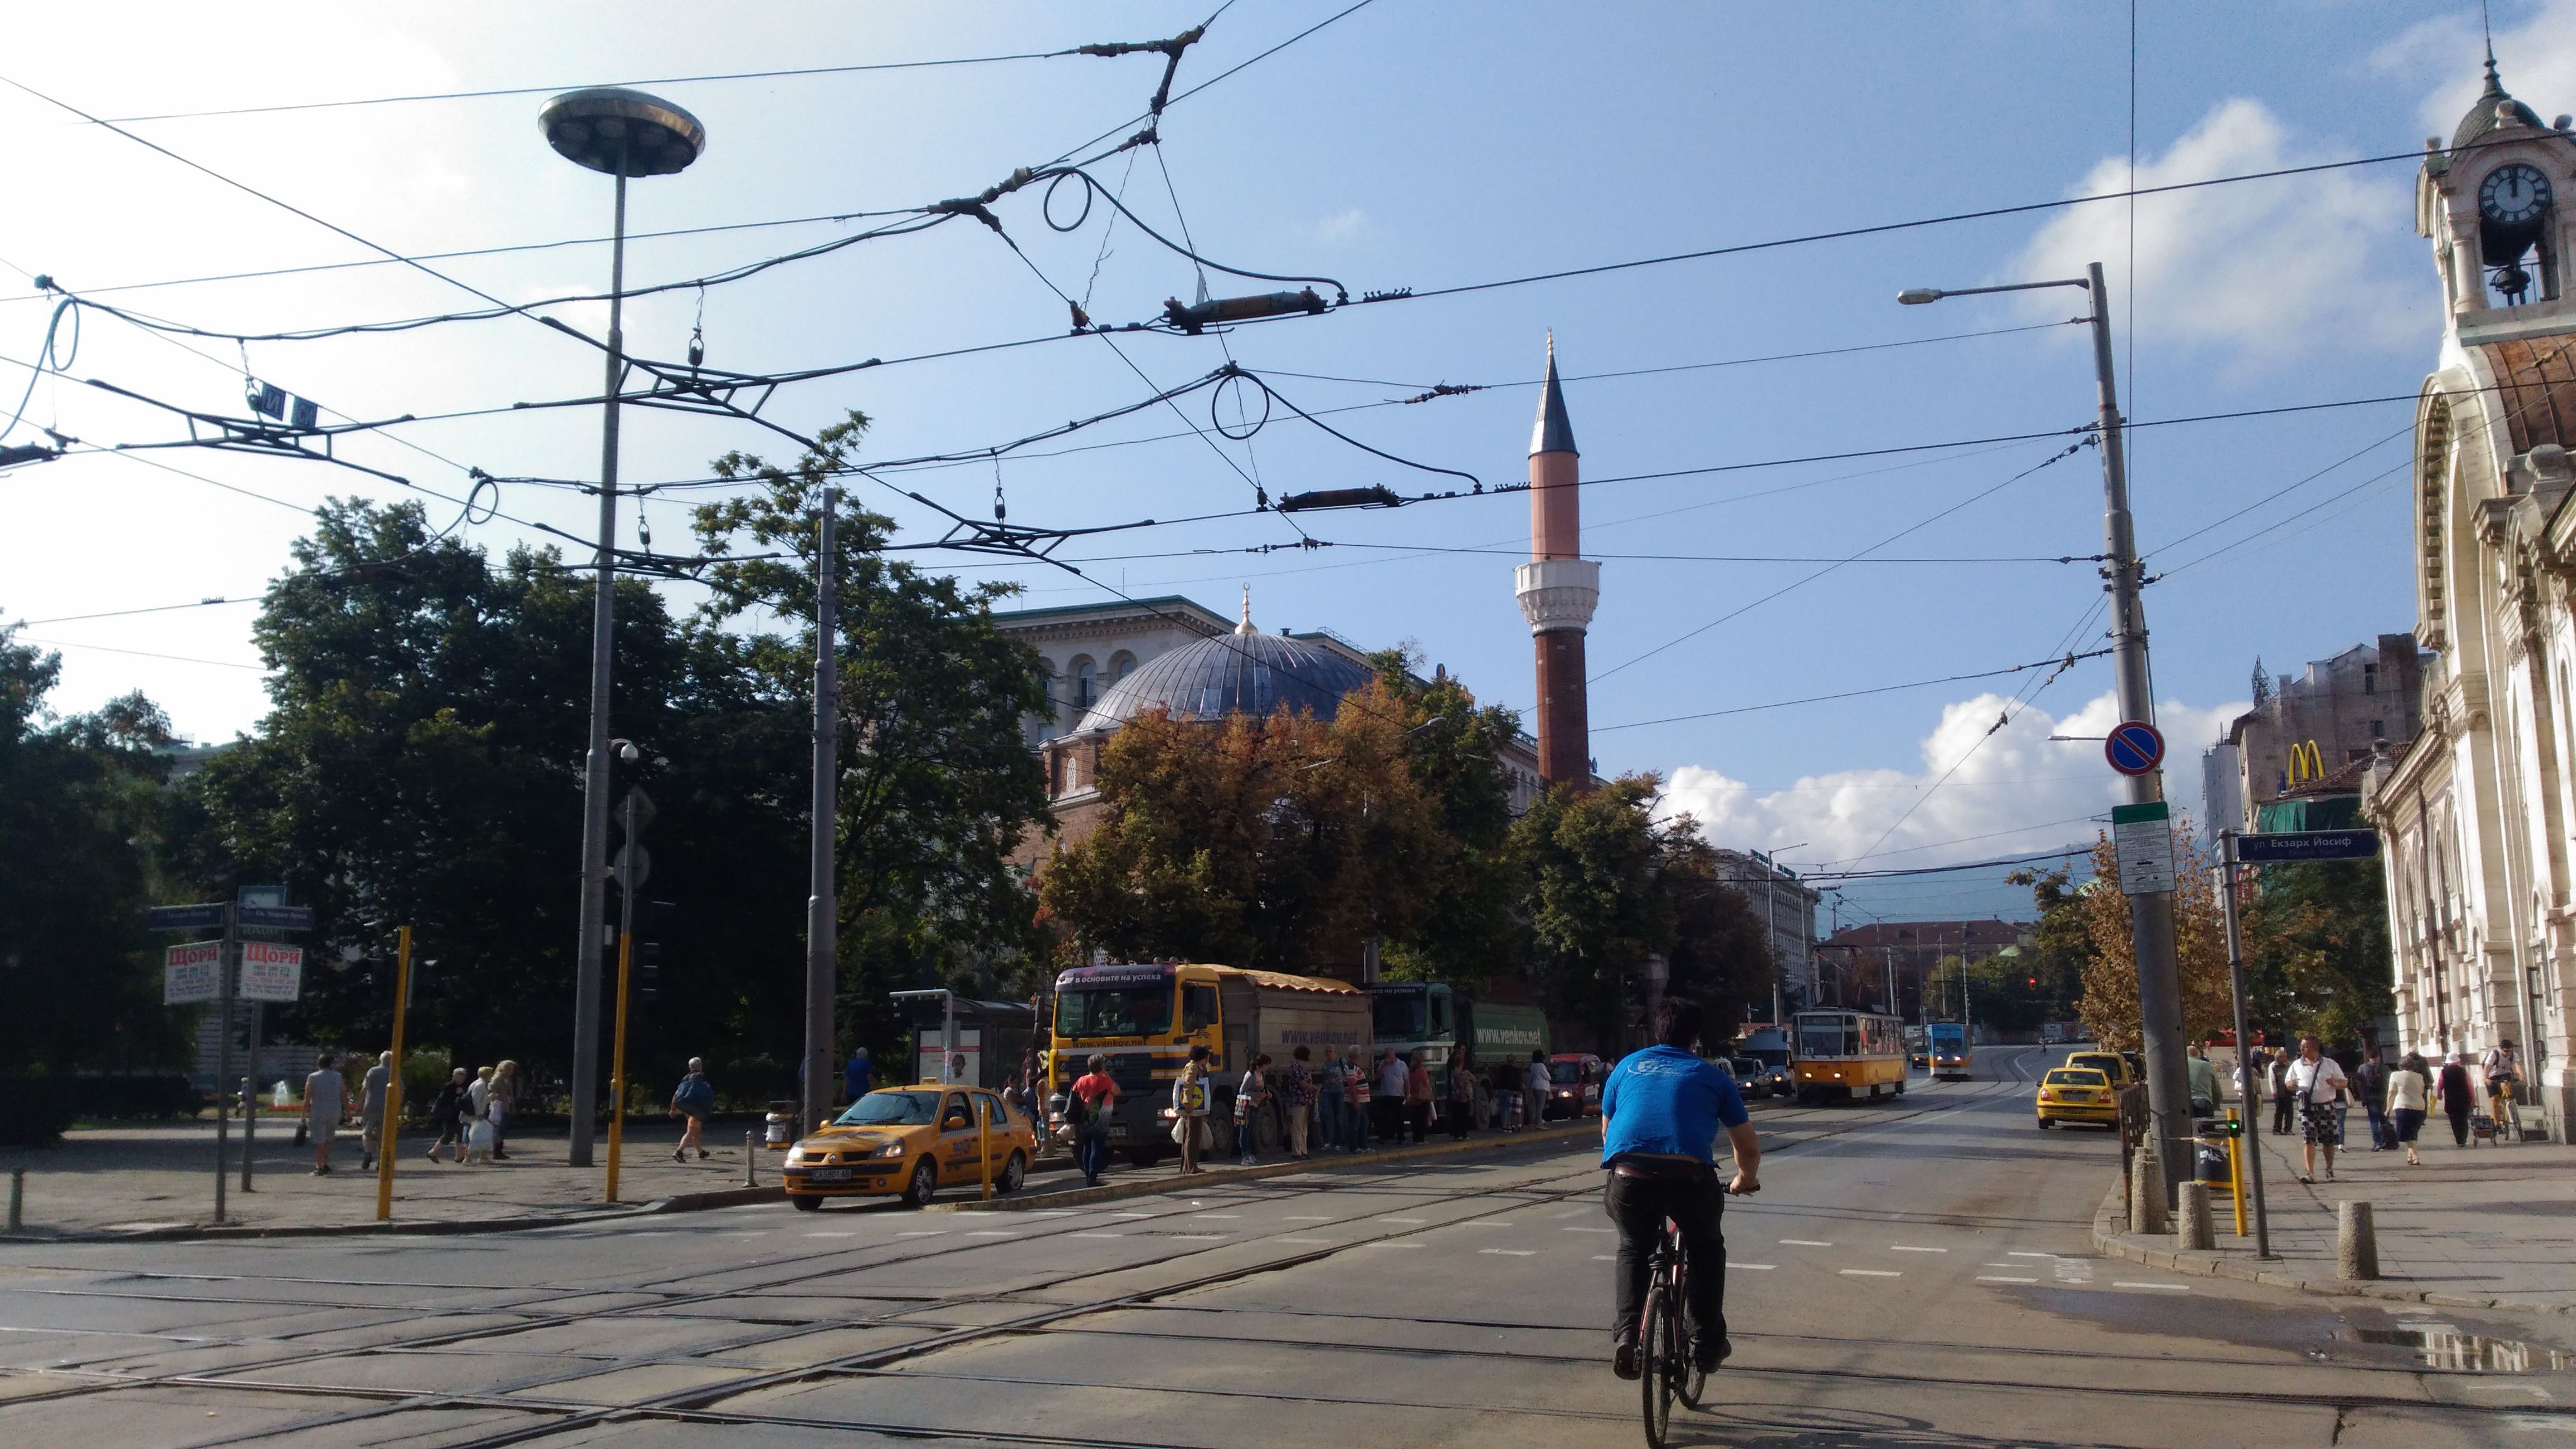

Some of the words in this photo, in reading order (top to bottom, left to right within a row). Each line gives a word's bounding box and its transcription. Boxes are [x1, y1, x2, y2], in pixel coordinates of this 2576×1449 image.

[2271, 839, 2309, 848] Екзарх
[2313, 836, 2351, 847] Йосиф
[1133, 974, 1161, 982] успеха
[1282, 1026, 1358, 1045] www.venkov.net
[1476, 1024, 1541, 1045] www.venkov.net
[1072, 1038, 1147, 1048] www.venkov.net
